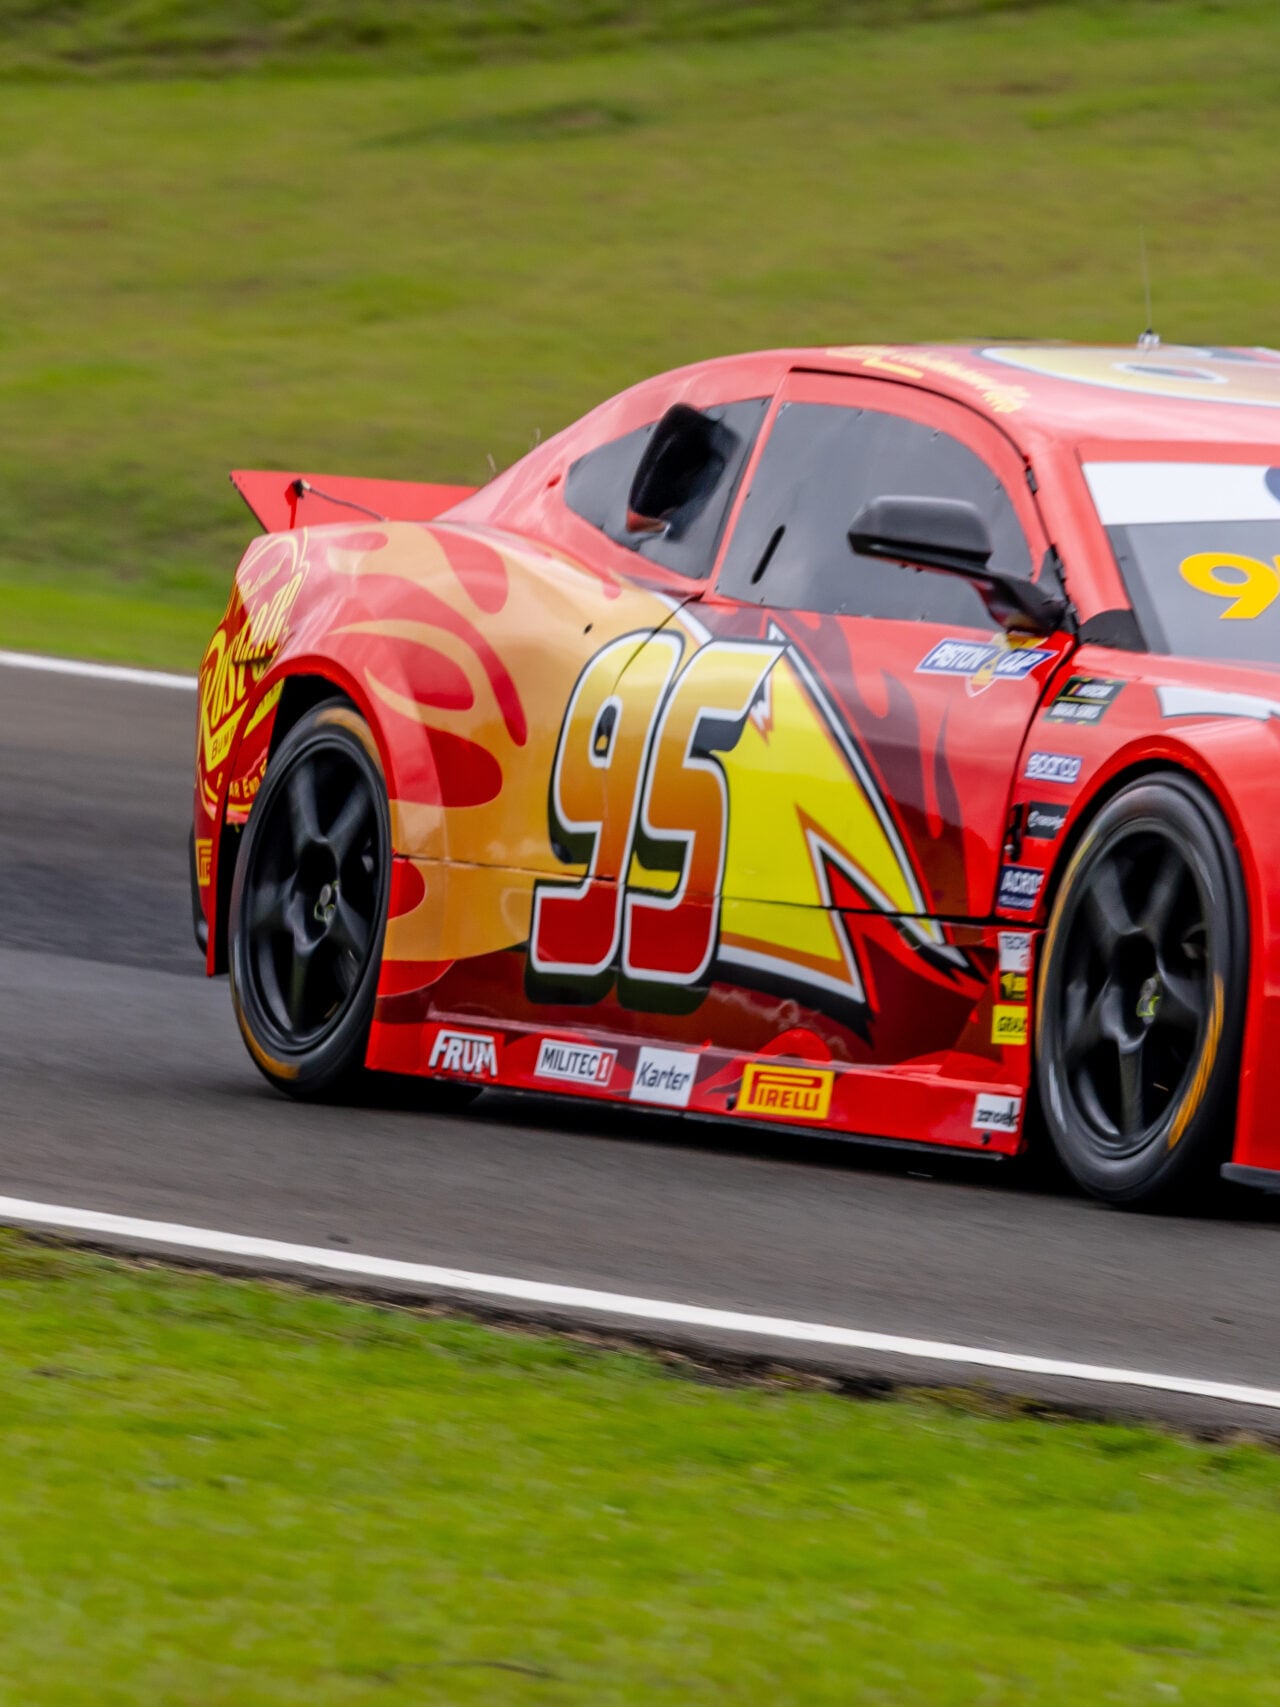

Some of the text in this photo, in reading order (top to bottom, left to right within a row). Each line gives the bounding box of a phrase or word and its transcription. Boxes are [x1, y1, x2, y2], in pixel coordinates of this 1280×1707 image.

[923, 641, 1046, 674] PISTON CUP
[528, 628, 790, 995] 95
[428, 1029, 498, 1077] FRUM
[636, 1062, 691, 1091] Karter
[747, 1071, 824, 1112] PIRELLI
